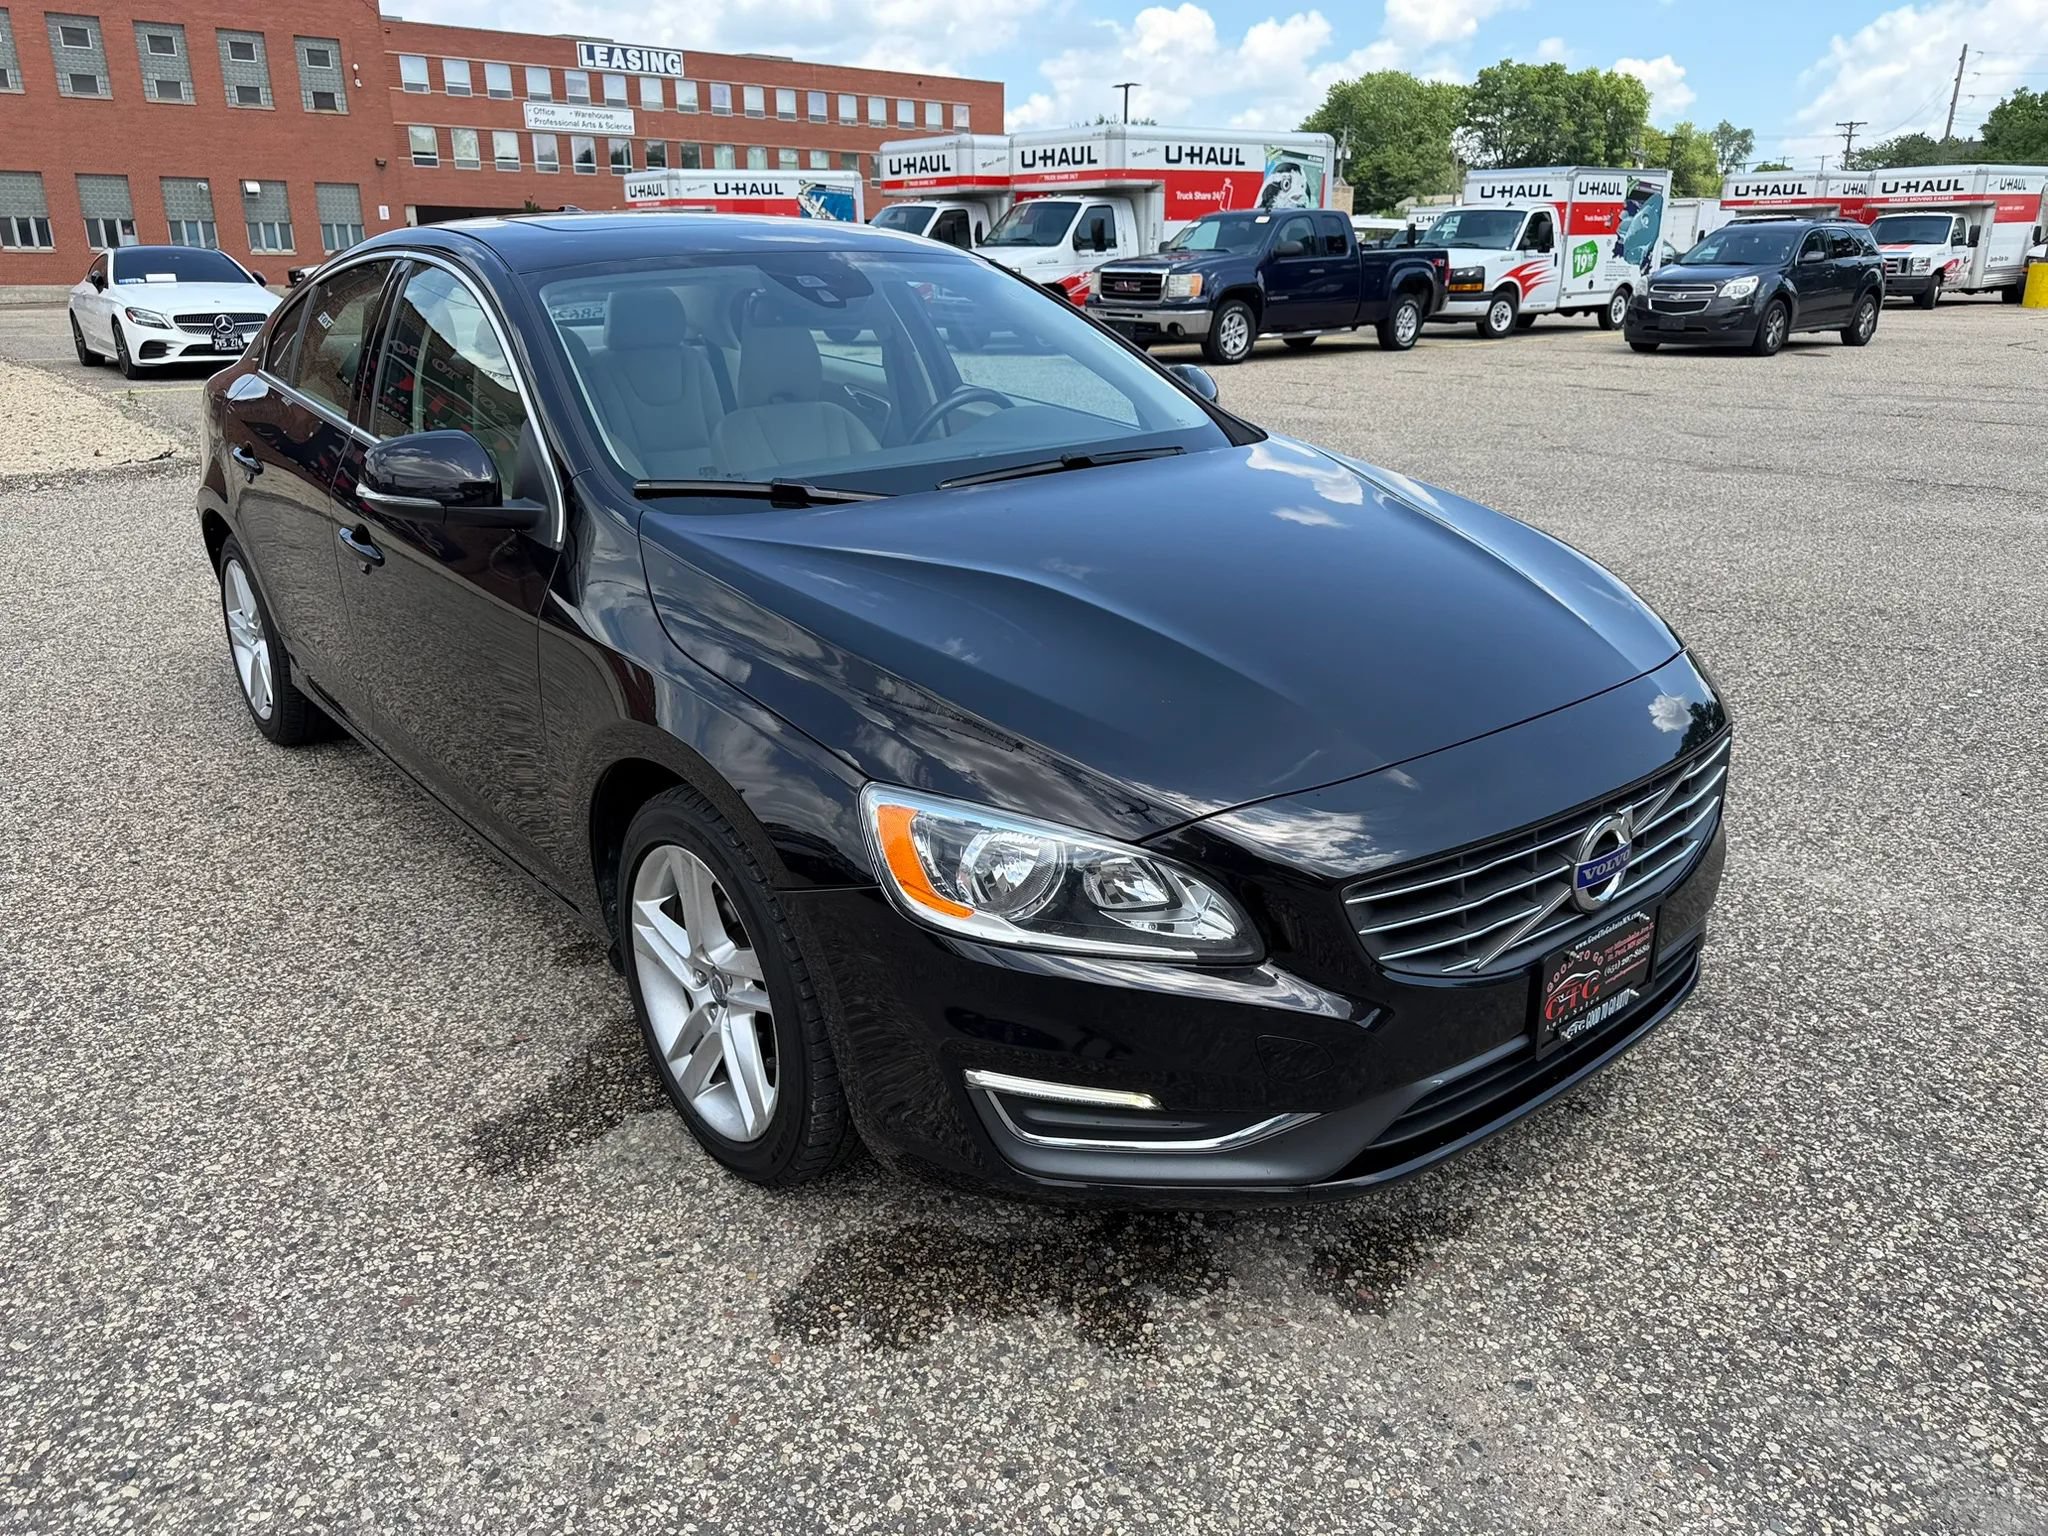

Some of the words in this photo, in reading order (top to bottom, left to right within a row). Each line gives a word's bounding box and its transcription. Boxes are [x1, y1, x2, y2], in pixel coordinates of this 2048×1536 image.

[580, 44, 682, 75] LEASING
[533, 107, 555, 116] Office
[574, 111, 614, 120] Warehouse
[534, 117, 580, 127] Professional
[581, 120, 596, 129] Arts
[605, 122, 632, 131] Science
[1021, 145, 1099, 169] U-HAUL
[1165, 145, 1245, 166] U-HAUL
[889, 154, 951, 175] U-HAUL
[629, 183, 666, 198] U-HAUL
[714, 182, 784, 196] U-HAUL
[1480, 184, 1553, 199] U-HAUL
[1579, 182, 1622, 196] U-HAUL
[1735, 184, 1807, 196] U-HAUL
[1882, 180, 1964, 194] U-HAUL
[2000, 178, 2027, 190] U-HAUL
[1176, 191, 1193, 200] Truck
[1194, 191, 1211, 200] Share
[1212, 191, 1226, 202] 24/7
[1583, 850, 1630, 880] VOLVO
[1592, 951, 1604, 966] GO
[1545, 1015, 1569, 1033] Auto
[1573, 996, 1600, 1016] Sales
[1585, 1006, 1601, 1030] GOOD
[1600, 1001, 1609, 1021] TO
